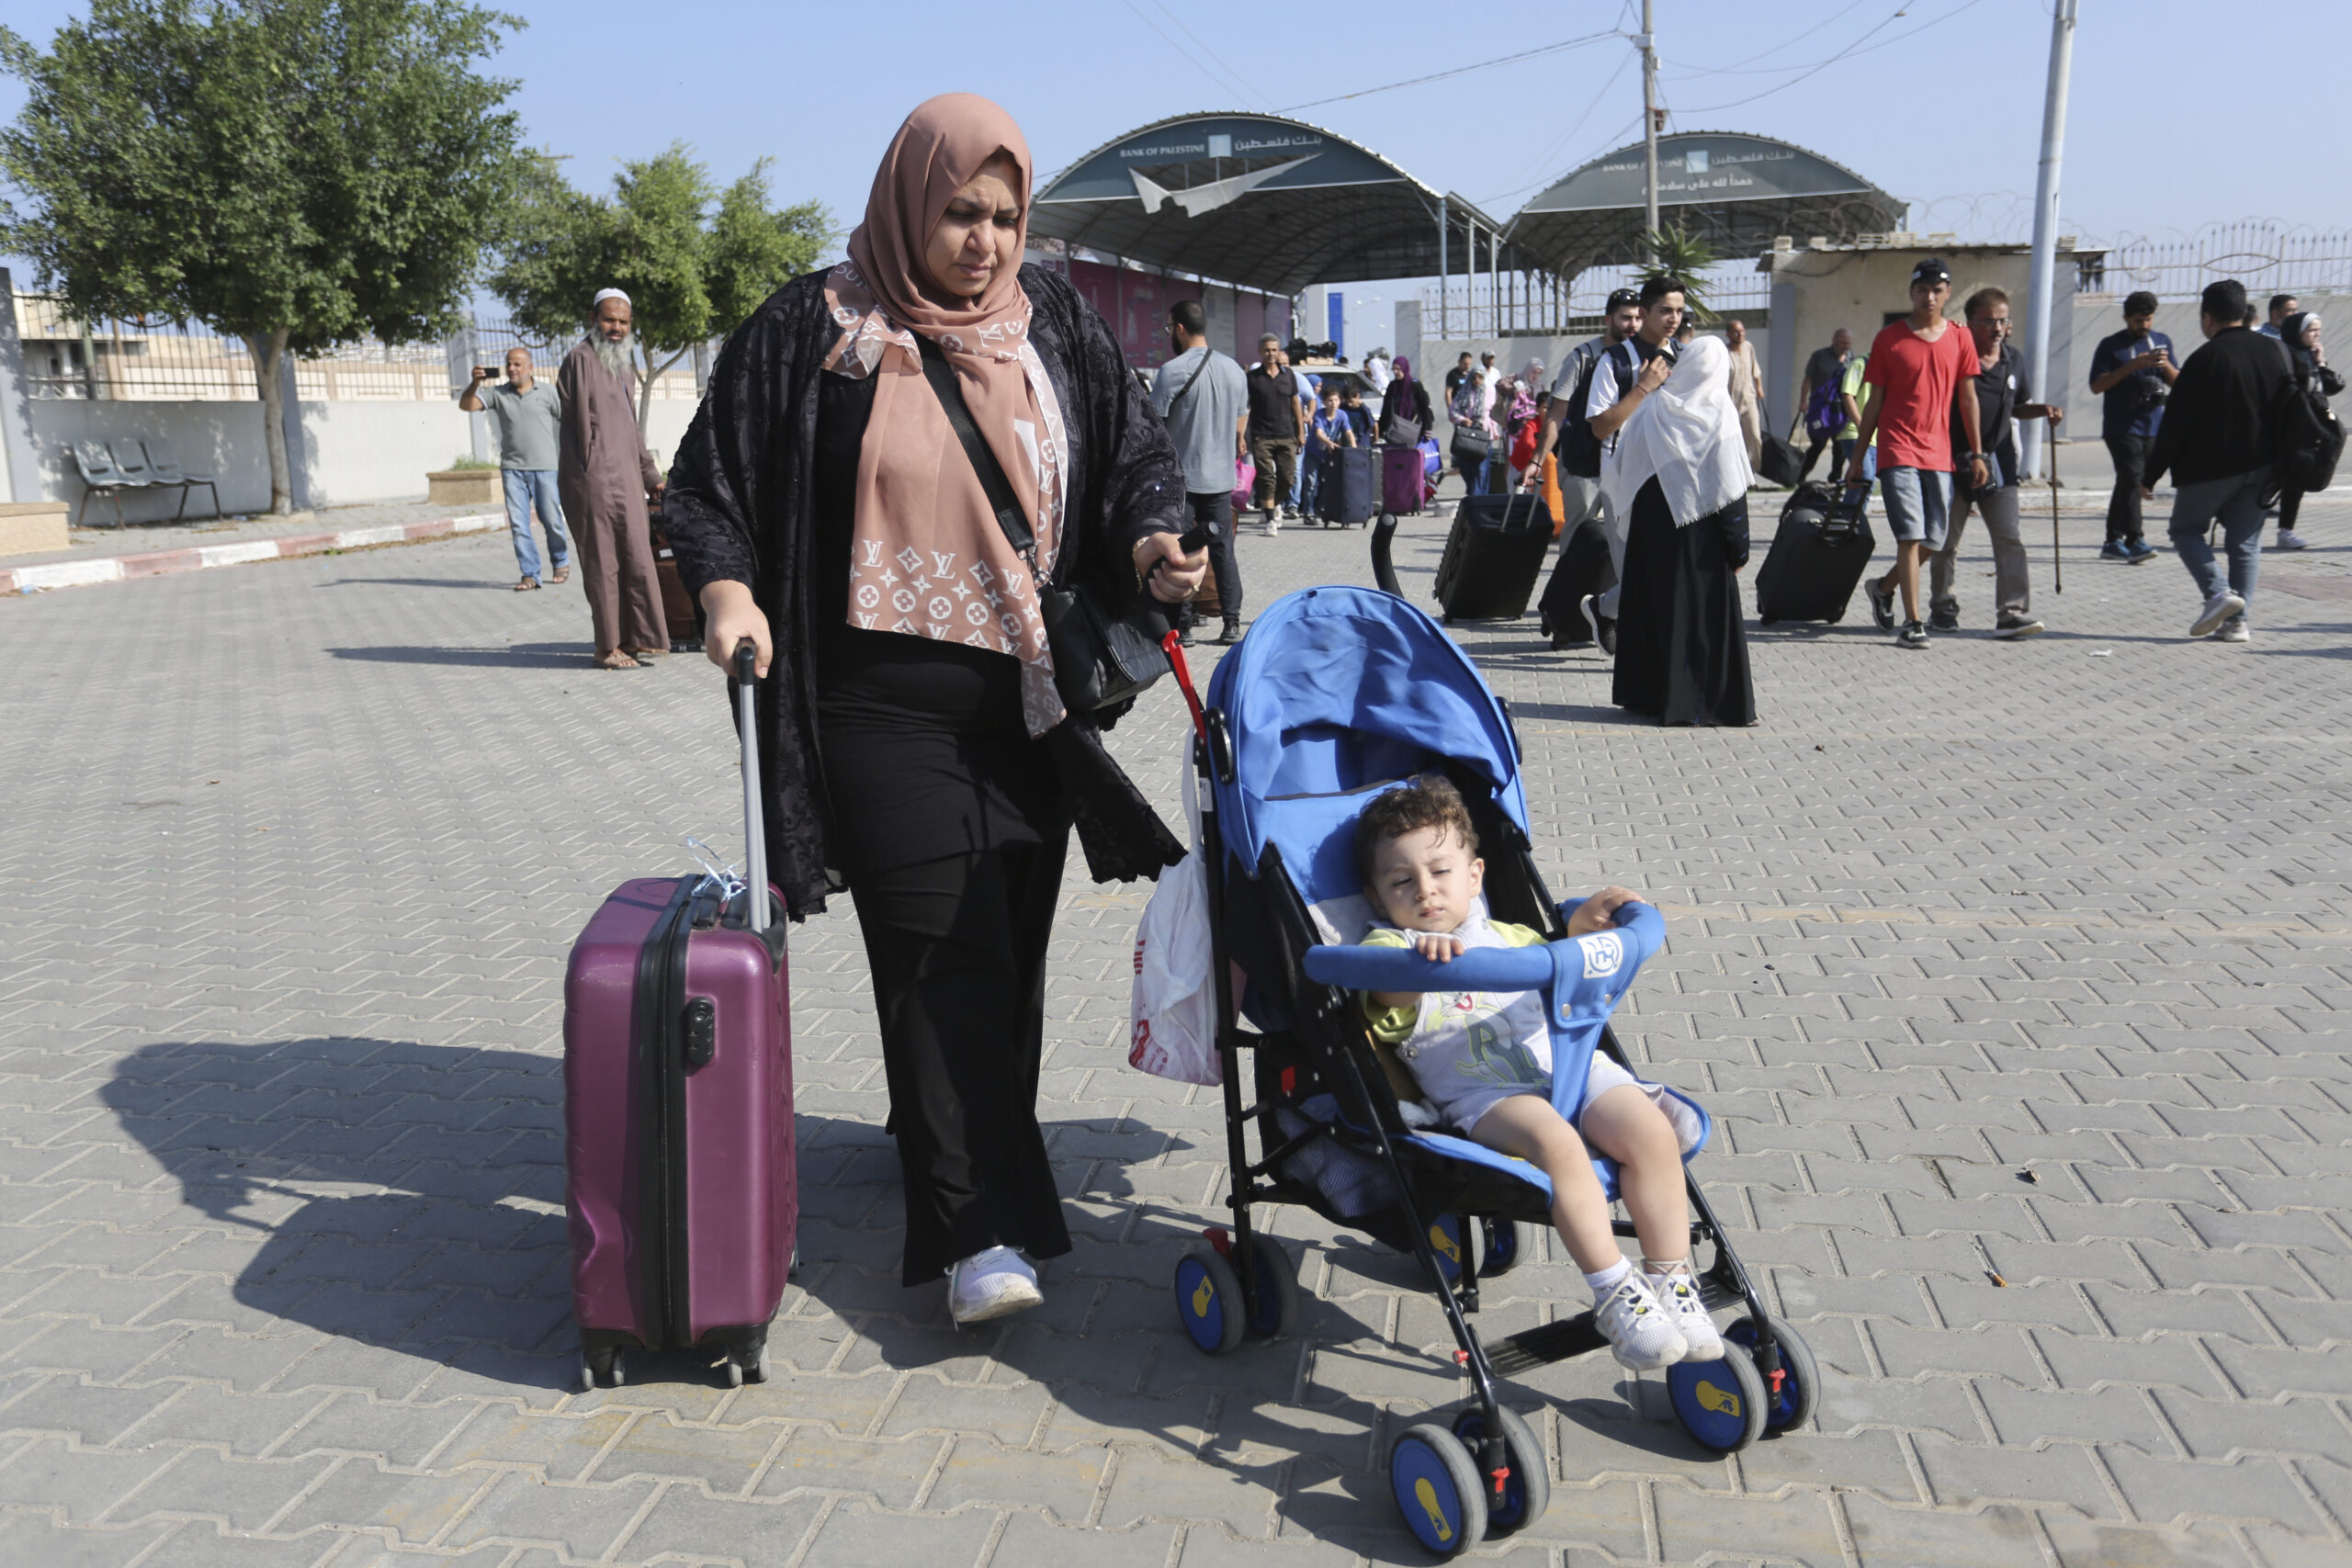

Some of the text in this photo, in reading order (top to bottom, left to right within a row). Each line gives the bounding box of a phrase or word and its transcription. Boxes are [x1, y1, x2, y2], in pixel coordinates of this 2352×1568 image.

[1120, 144, 1205, 157] BANK OF PALESTINE
[1235, 137, 1290, 151] فلسطين
[862, 539, 884, 568] LV
[931, 551, 956, 579] LV
[1002, 569, 1025, 600] LV
